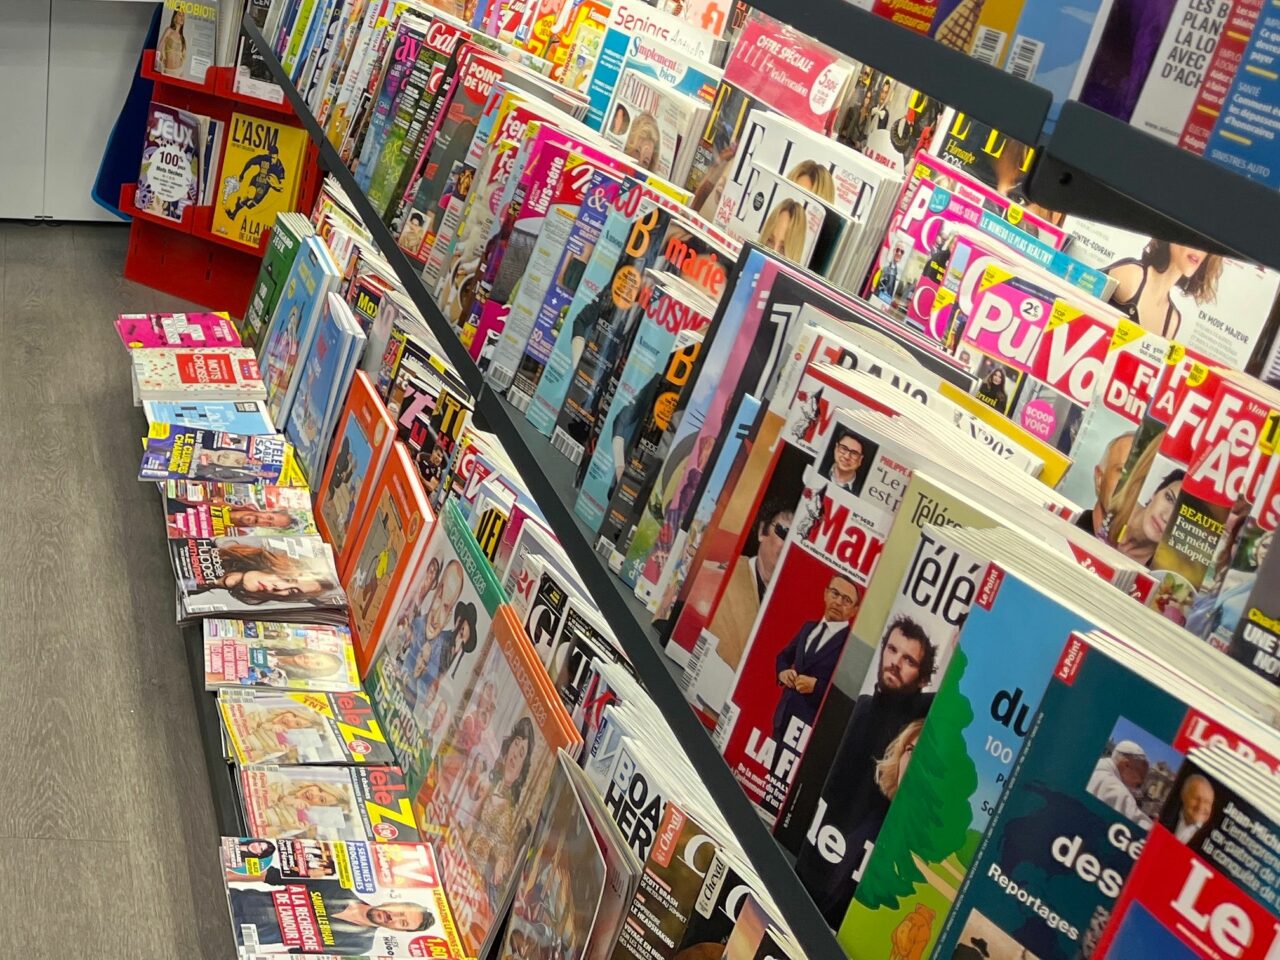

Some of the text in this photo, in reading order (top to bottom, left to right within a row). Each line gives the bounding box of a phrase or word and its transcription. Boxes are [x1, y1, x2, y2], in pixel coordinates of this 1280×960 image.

[630, 36, 677, 70] Simplement
[757, 35, 814, 73] OFFRE SPÉCIALE
[1167, 46, 1207, 70] AVEC
[469, 62, 502, 83] POINT
[1238, 82, 1262, 97] SANTÉ
[151, 112, 193, 148] JEUX
[231, 117, 279, 151] L'ASM
[1224, 116, 1275, 140] d'honoraires
[1211, 148, 1270, 177] SINISTRES AUTO
[535, 156, 565, 214] Hors-série
[1208, 313, 1250, 344] MODE MAJEUR
[192, 353, 209, 384] CROISÉS
[207, 359, 221, 380] MOTS
[1024, 414, 1051, 433] VOICI
[1025, 404, 1055, 425] SCOOP
[1176, 516, 1208, 539] Forme
[1179, 504, 1226, 535] BEAUTÉ
[808, 495, 884, 576] Mar
[198, 540, 217, 585] Huppert
[211, 548, 225, 577] Isabelle
[1176, 542, 1210, 567] adopter
[1064, 639, 1081, 667] Point
[984, 735, 1013, 765] 100
[363, 798, 417, 842] Z
[806, 797, 848, 863] le
[347, 842, 364, 891] PROGRAMMES
[355, 848, 371, 879] SEMAINES
[390, 845, 433, 884] TV
[704, 857, 724, 901] Cheval
[1051, 835, 1124, 899] des
[293, 894, 309, 905] LA
[987, 862, 1080, 942] Reportages
[1170, 858, 1255, 958] Le
[275, 894, 297, 939] DE L'AMOUR
[296, 906, 320, 951] RECHERCHE
[311, 891, 335, 945] SAMUEL BIHAN
[382, 937, 394, 956] HUGO
